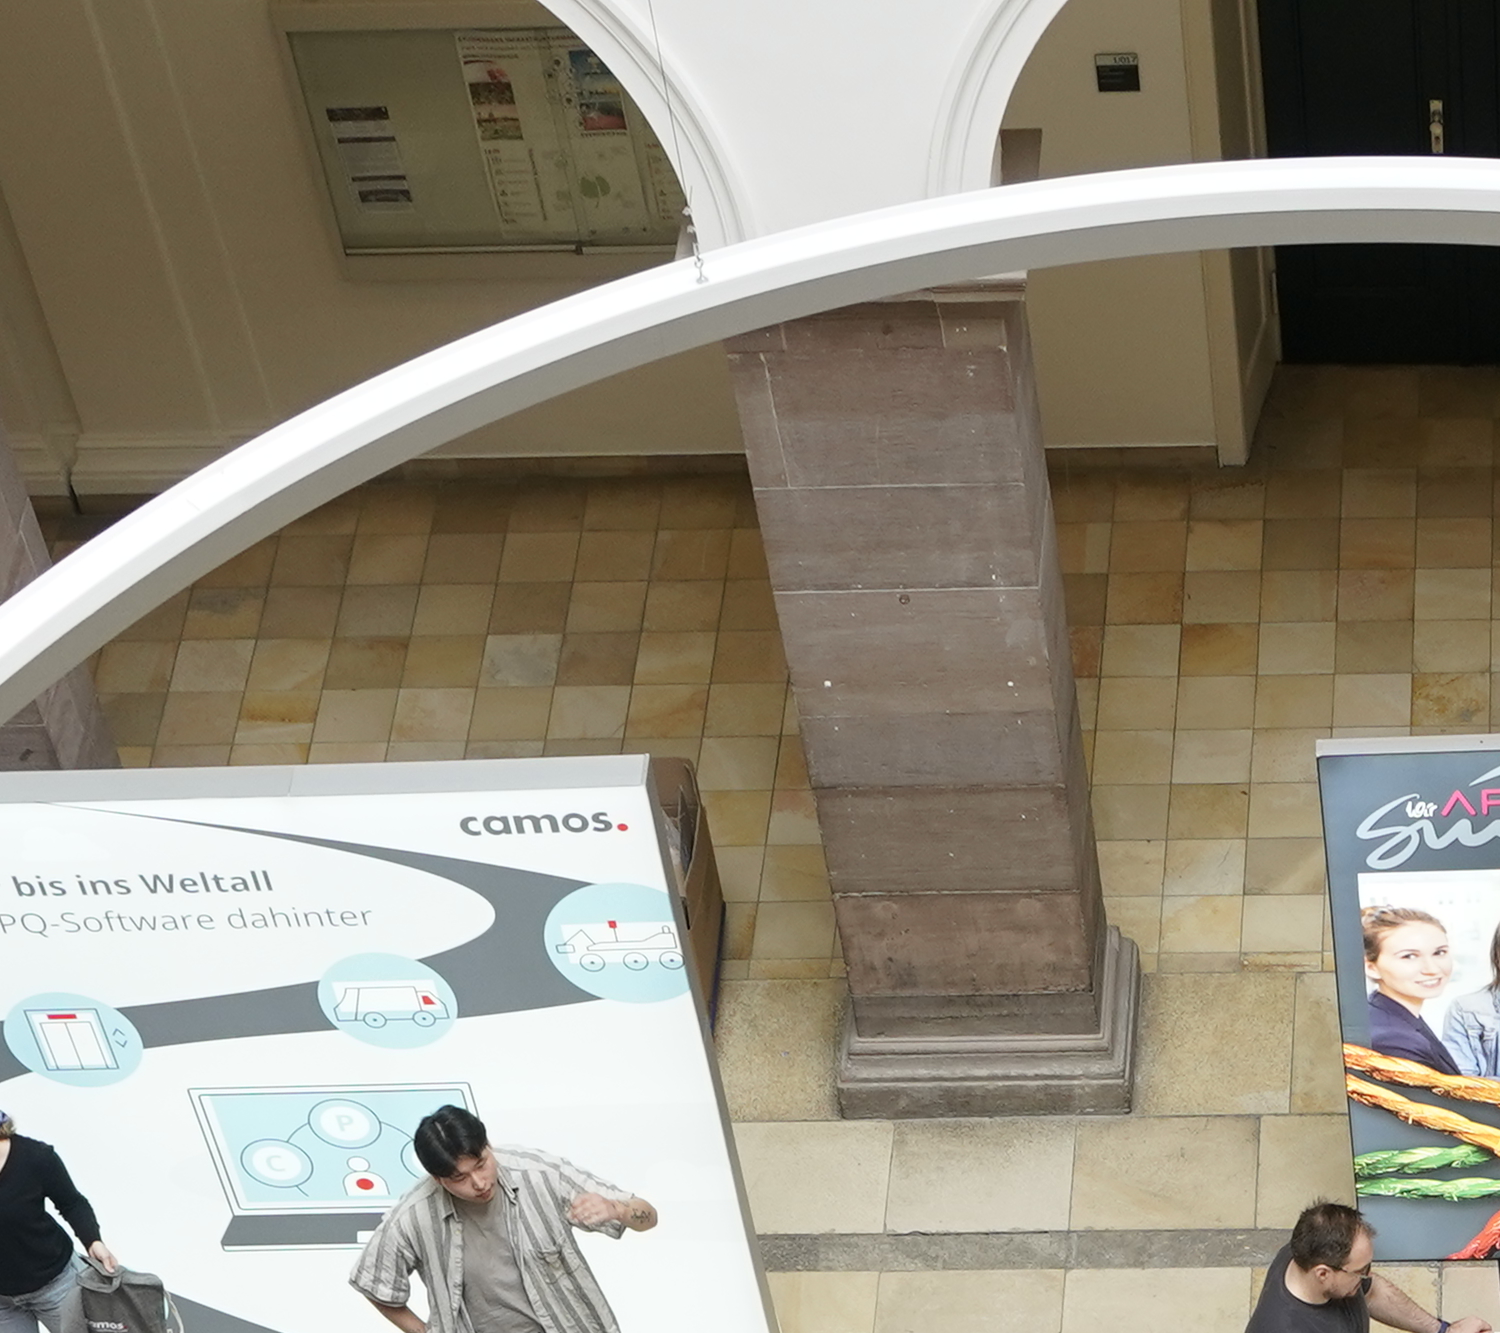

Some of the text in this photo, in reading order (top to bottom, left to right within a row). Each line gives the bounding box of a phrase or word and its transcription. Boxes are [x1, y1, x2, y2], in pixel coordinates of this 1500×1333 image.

[459, 805, 630, 839] camos.
[11, 872, 67, 897] bis
[75, 873, 133, 896] ins
[138, 870, 274, 894] Weltall
[227, 905, 374, 932] dahinter
